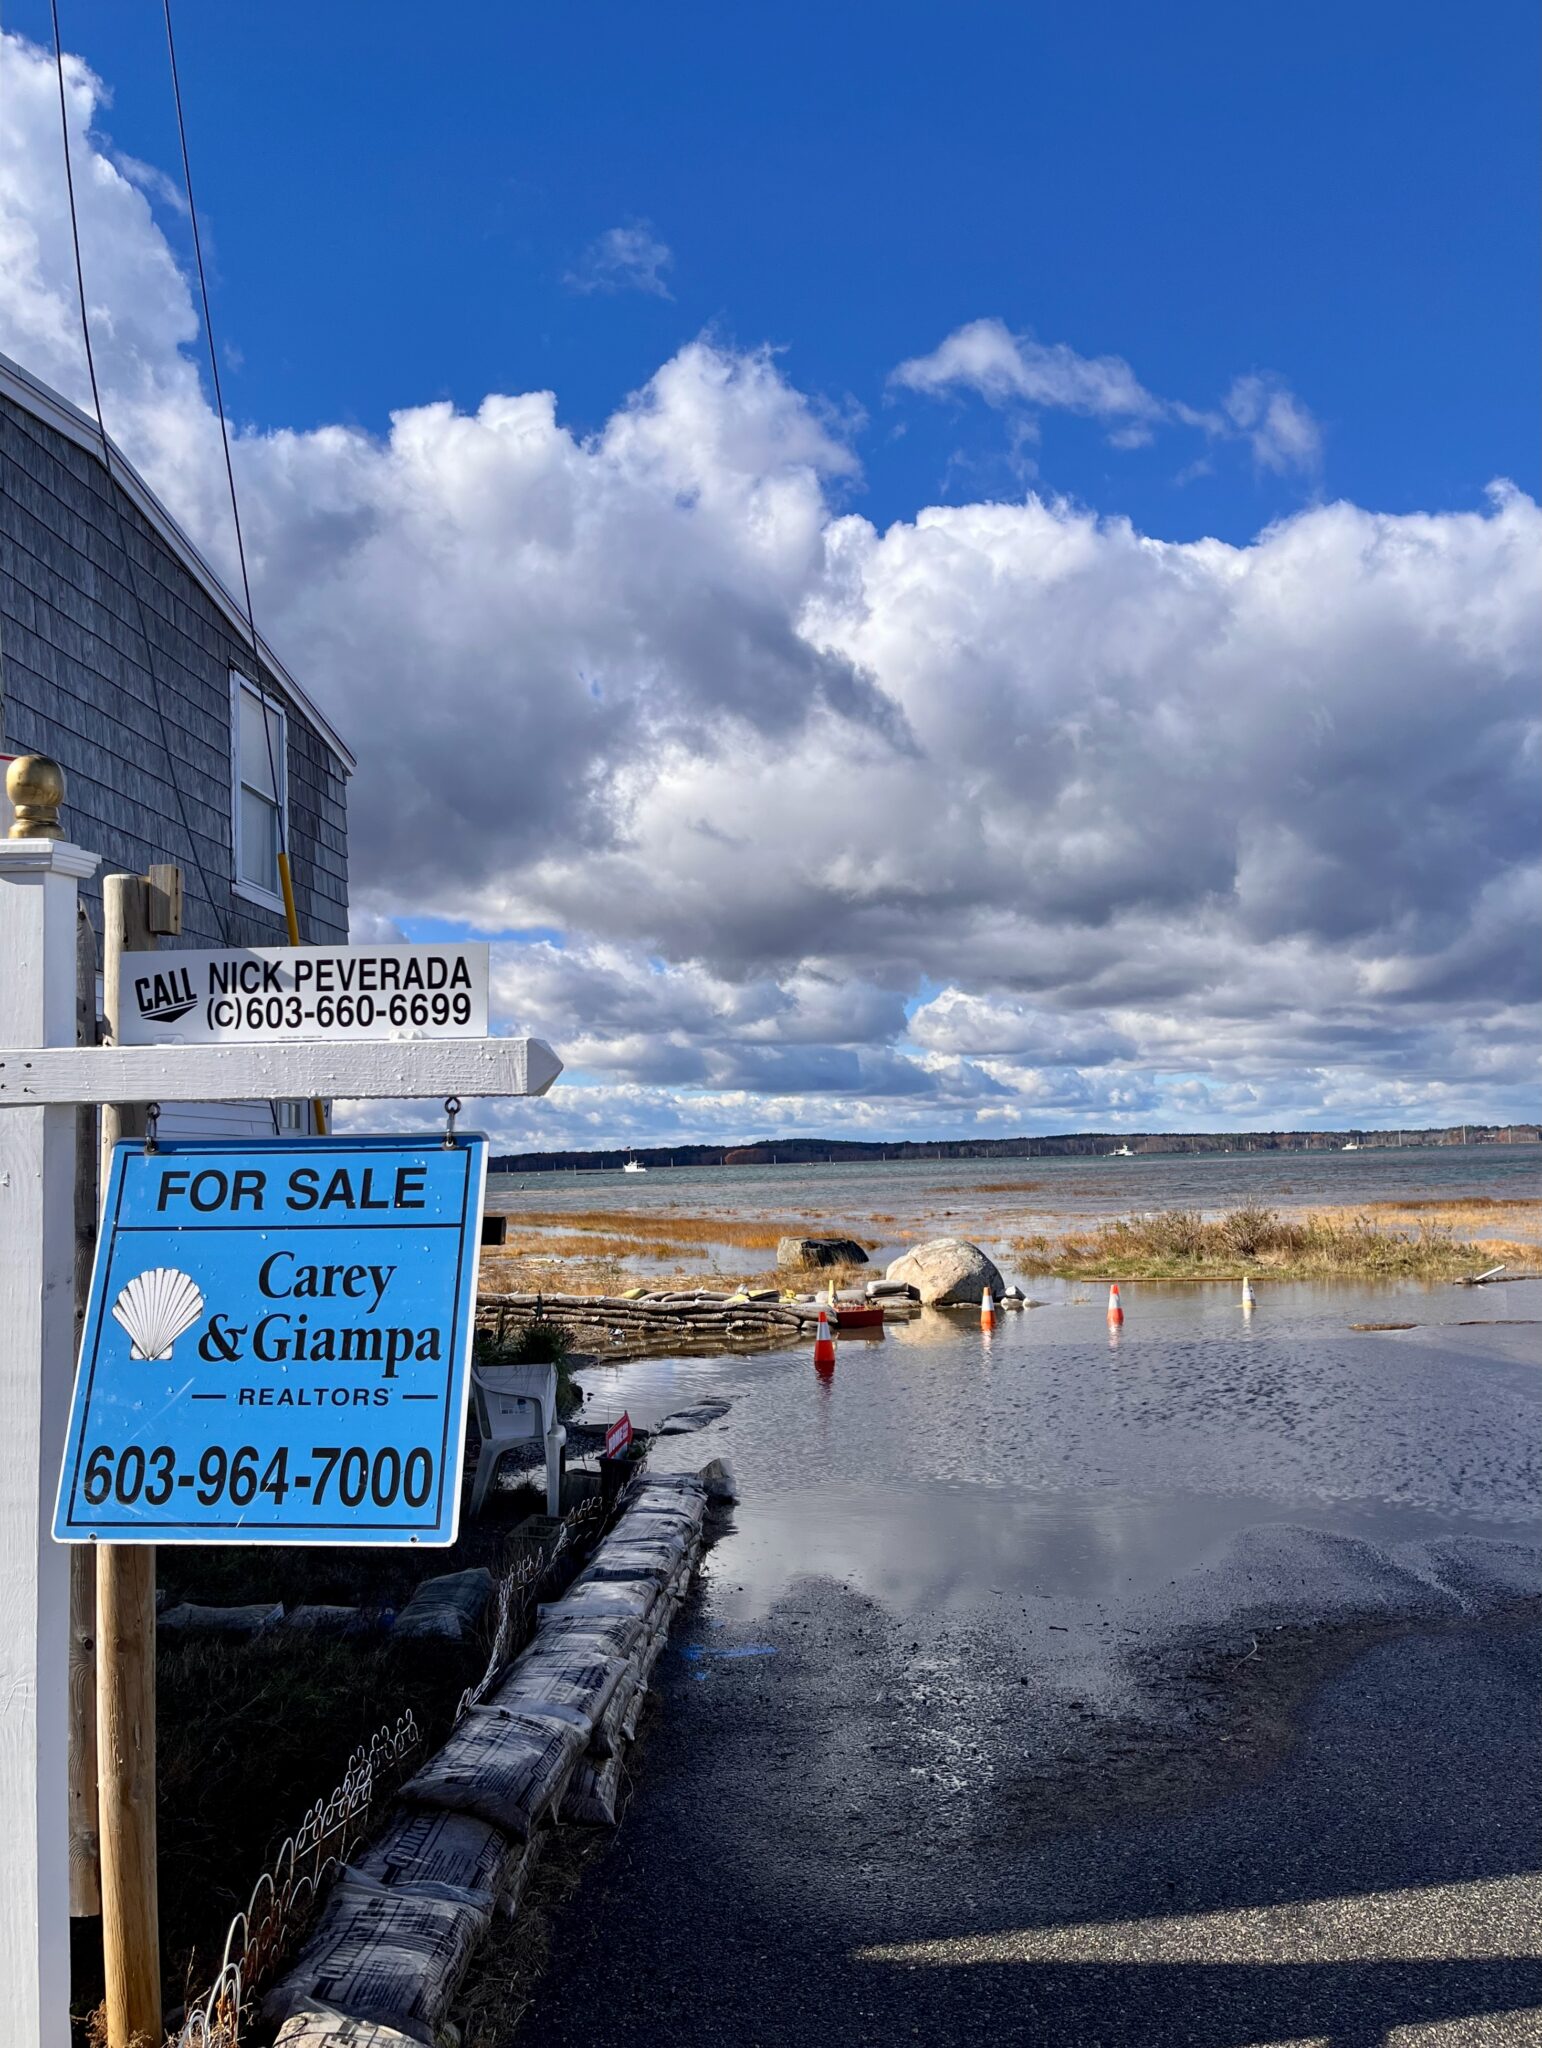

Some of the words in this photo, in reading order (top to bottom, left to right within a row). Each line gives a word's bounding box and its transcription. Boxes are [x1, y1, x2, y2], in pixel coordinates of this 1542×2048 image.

[134, 967, 198, 1013] CALL
[208, 960, 283, 995] NICK
[294, 956, 472, 993] PEVERADA
[157, 1169, 267, 1212] FOR
[286, 1167, 427, 1211] SALE
[258, 1251, 397, 1314] Carey
[83, 1445, 433, 1508] 603-964-7000
